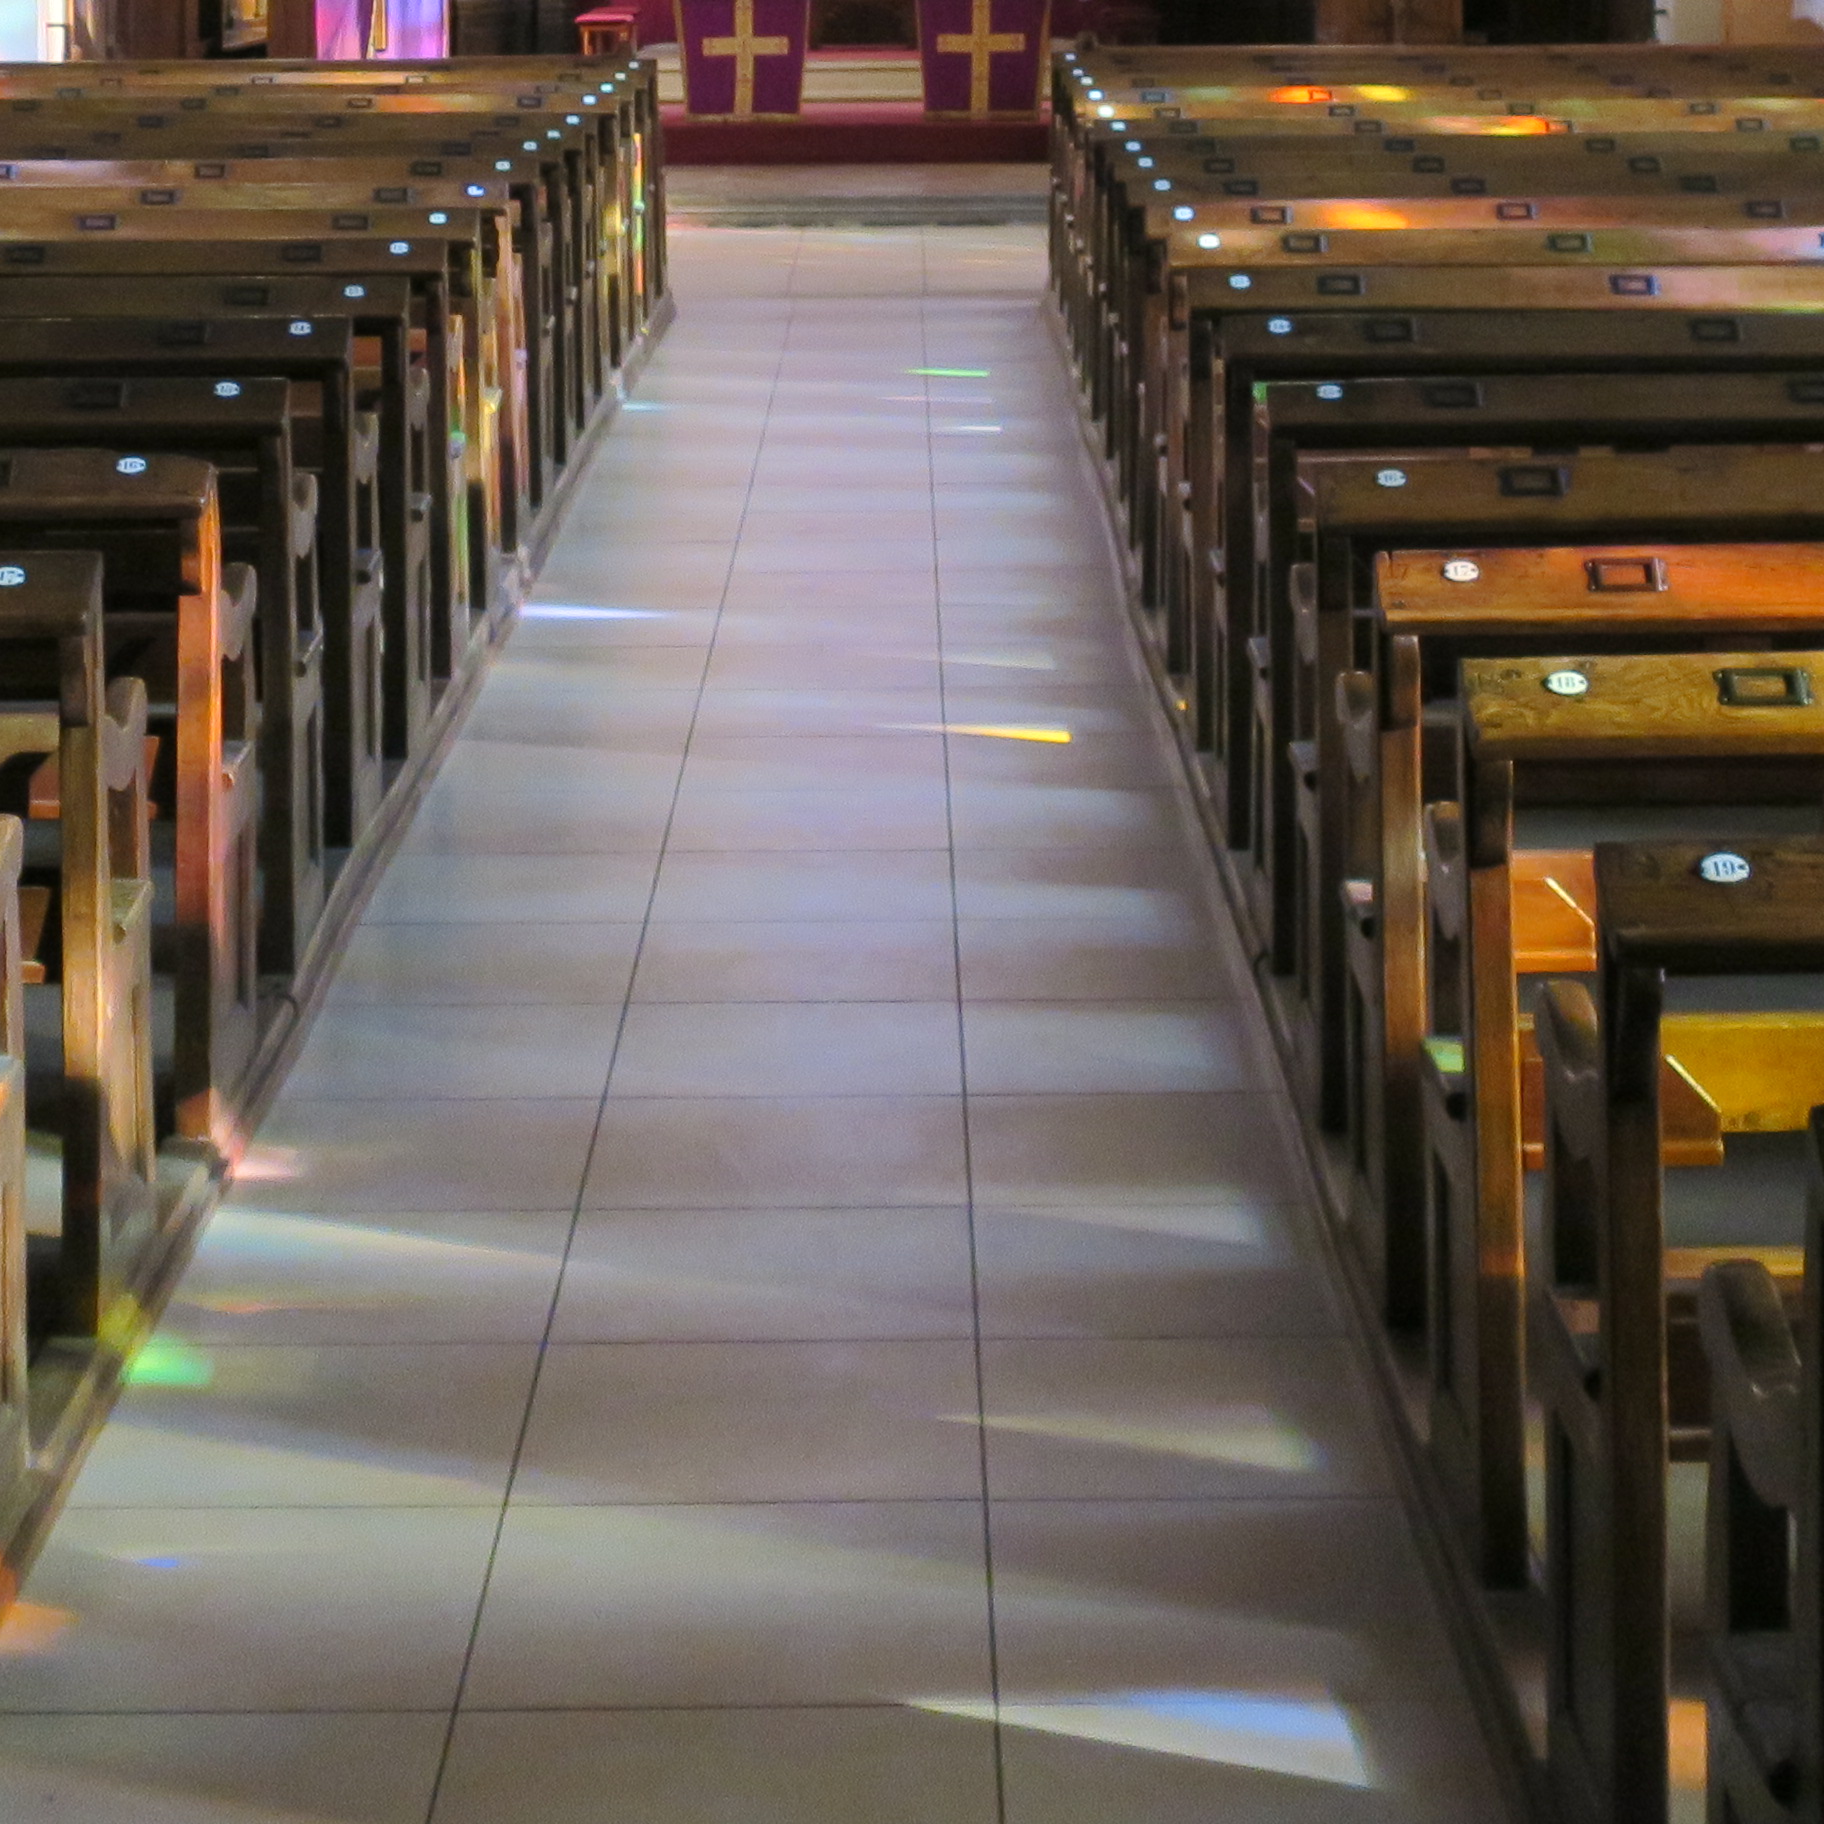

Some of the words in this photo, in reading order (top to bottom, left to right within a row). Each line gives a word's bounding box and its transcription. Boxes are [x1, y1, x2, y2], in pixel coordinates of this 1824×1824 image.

[0, 570, 17, 584] 17
[1453, 565, 1470, 577] 17
[1555, 675, 1576, 690] 18
[1712, 860, 1737, 878] 19
